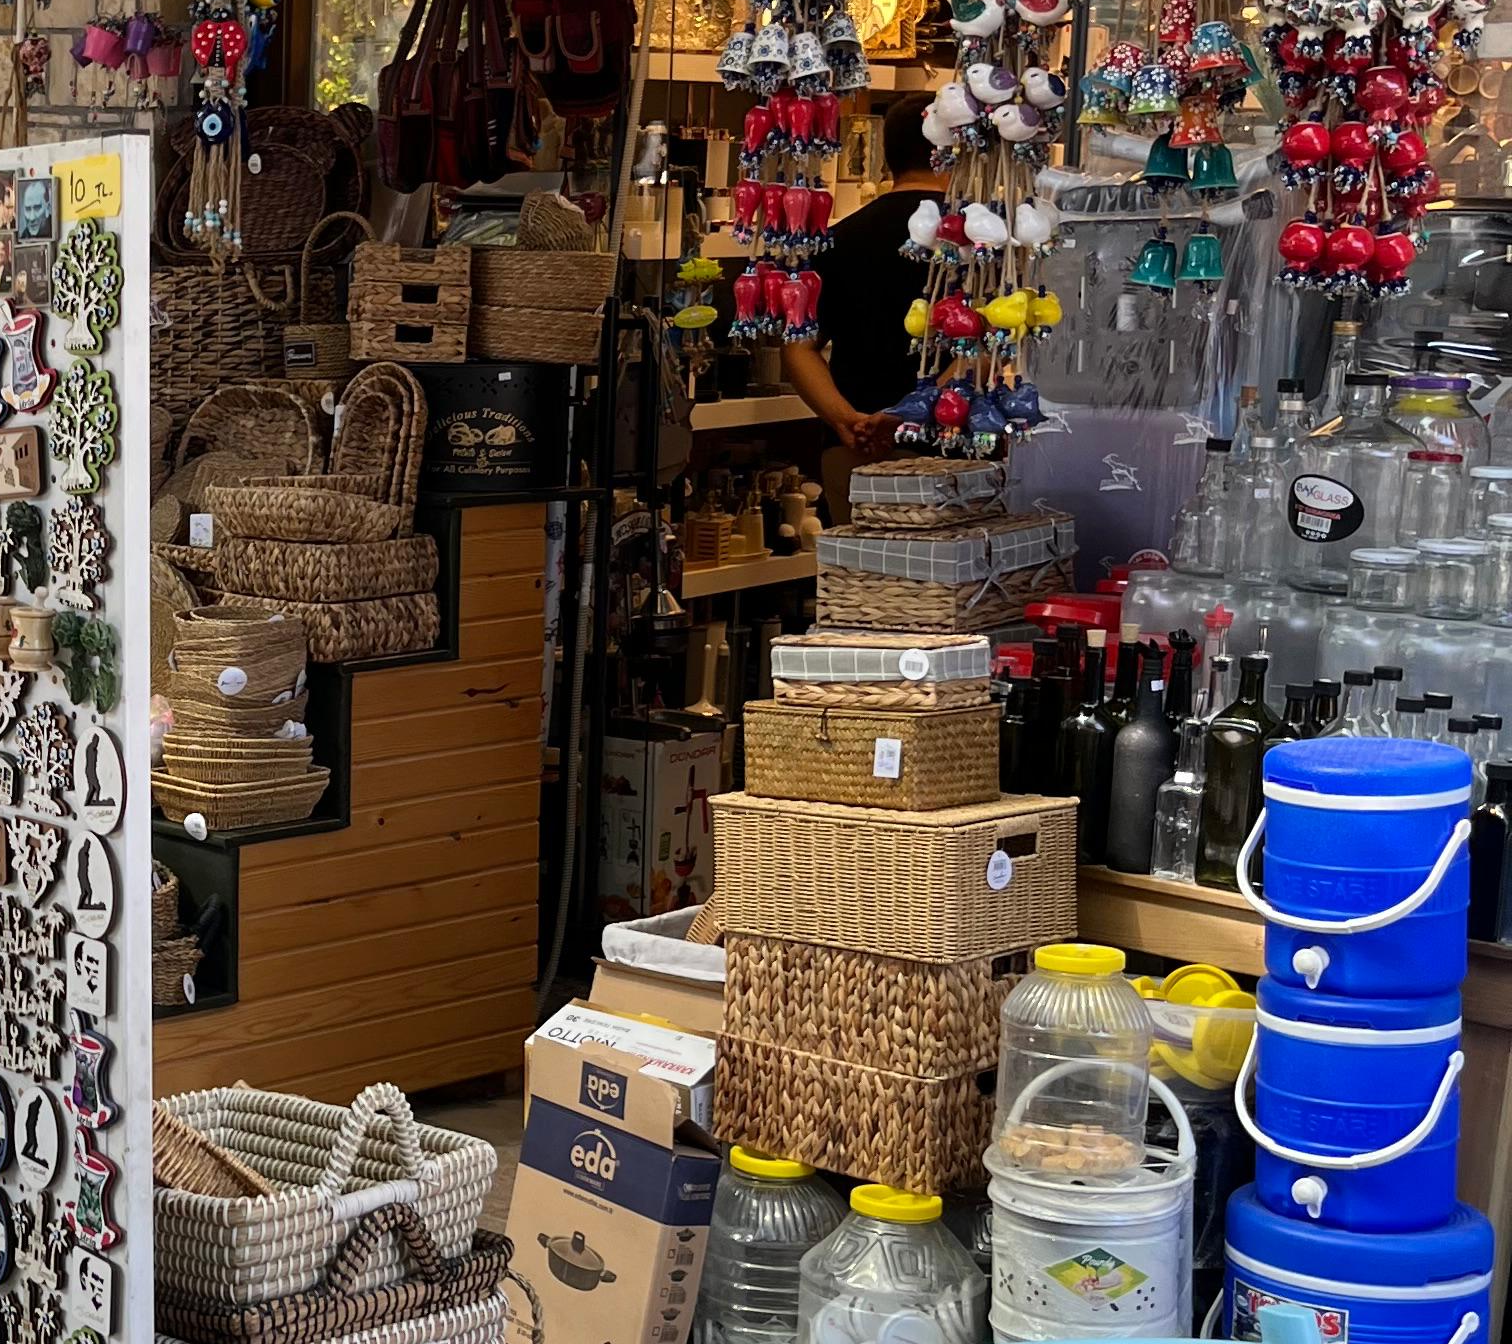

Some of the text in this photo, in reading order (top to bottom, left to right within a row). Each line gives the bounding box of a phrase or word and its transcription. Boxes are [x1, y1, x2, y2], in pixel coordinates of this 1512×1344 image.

[69, 170, 86, 203] 10
[482, 407, 536, 442] Traditions
[570, 1141, 617, 1181] eda
